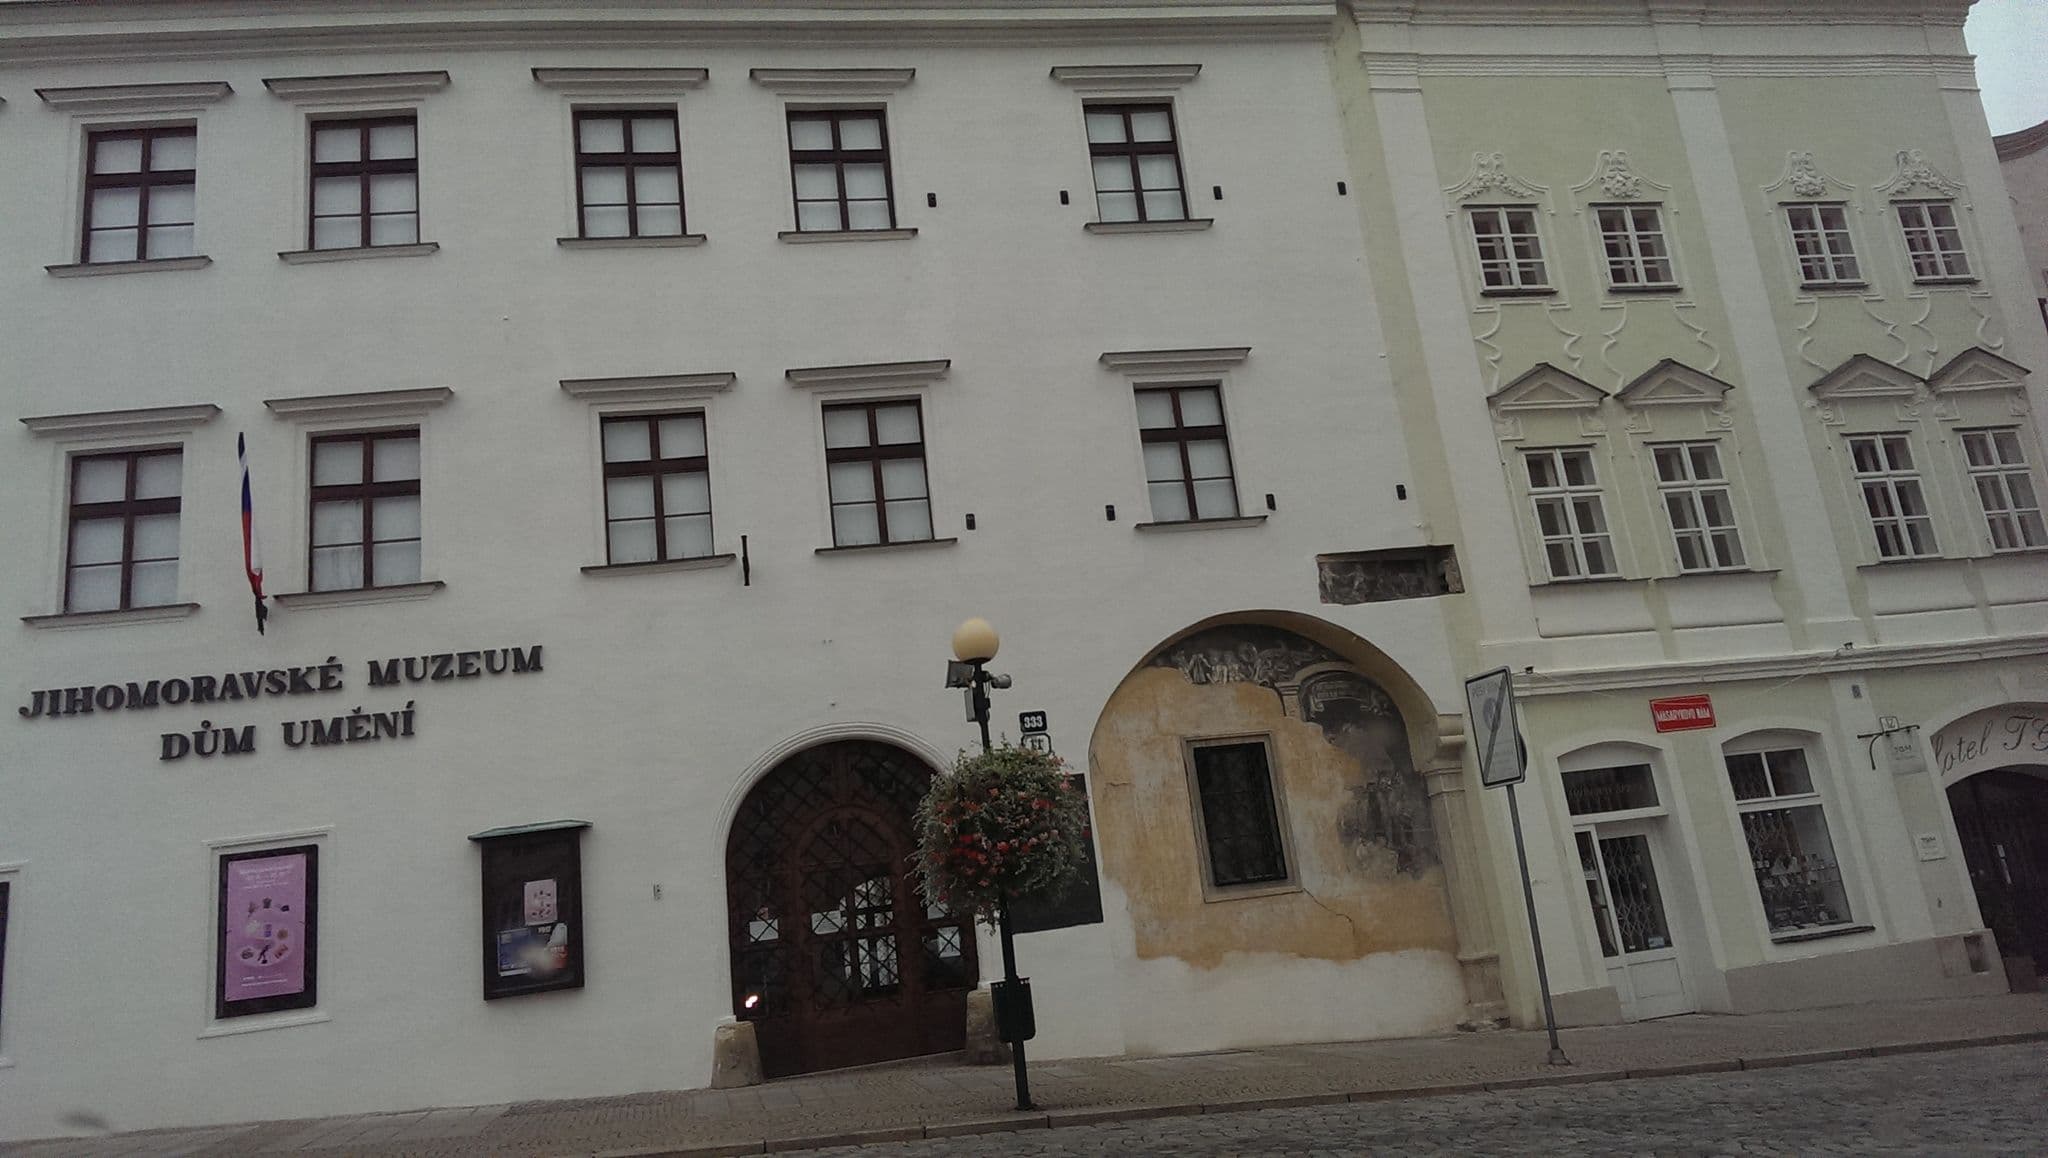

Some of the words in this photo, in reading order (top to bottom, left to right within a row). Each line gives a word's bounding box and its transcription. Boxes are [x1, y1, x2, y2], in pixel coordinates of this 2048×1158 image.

[19, 656, 343, 718] JIHOMORAVSKÉ
[367, 645, 543, 687] MUZEUM
[160, 720, 256, 761] DŮM
[281, 700, 416, 748] UMĚNÍ
[1024, 715, 1043, 728] 333
[1655, 708, 1696, 722] MASARYKOVO
